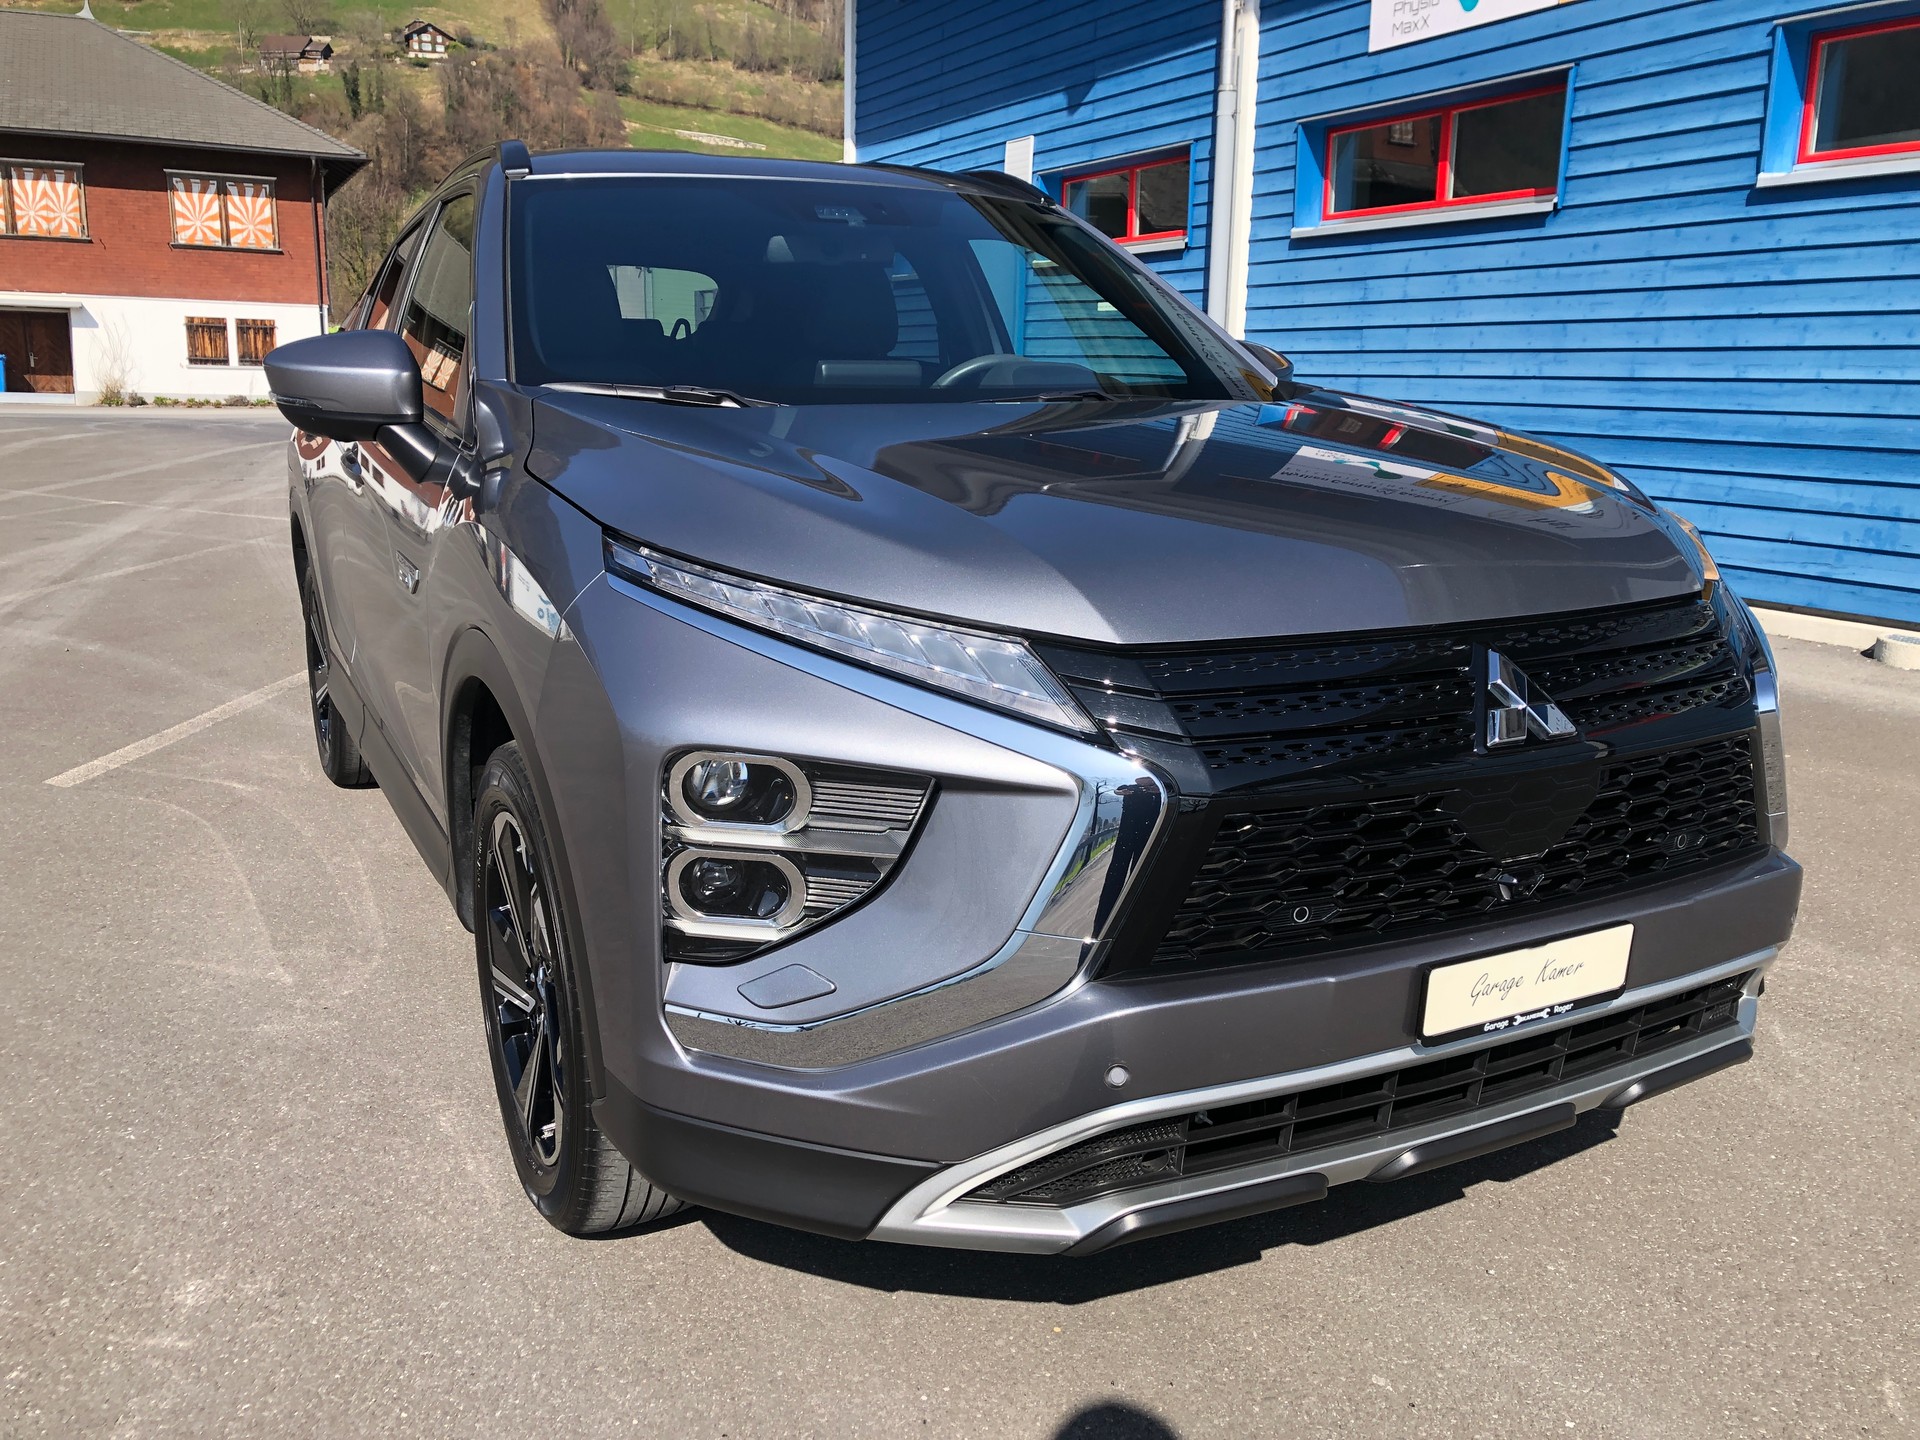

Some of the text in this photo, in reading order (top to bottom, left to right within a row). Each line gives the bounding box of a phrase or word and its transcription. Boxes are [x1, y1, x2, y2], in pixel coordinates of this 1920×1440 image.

[1391, 14, 1431, 37] MaxX
[1470, 958, 1584, 1006] Garage Kamer
[1483, 1019, 1509, 1032] Garage
[1553, 1002, 1574, 1014] Roger
